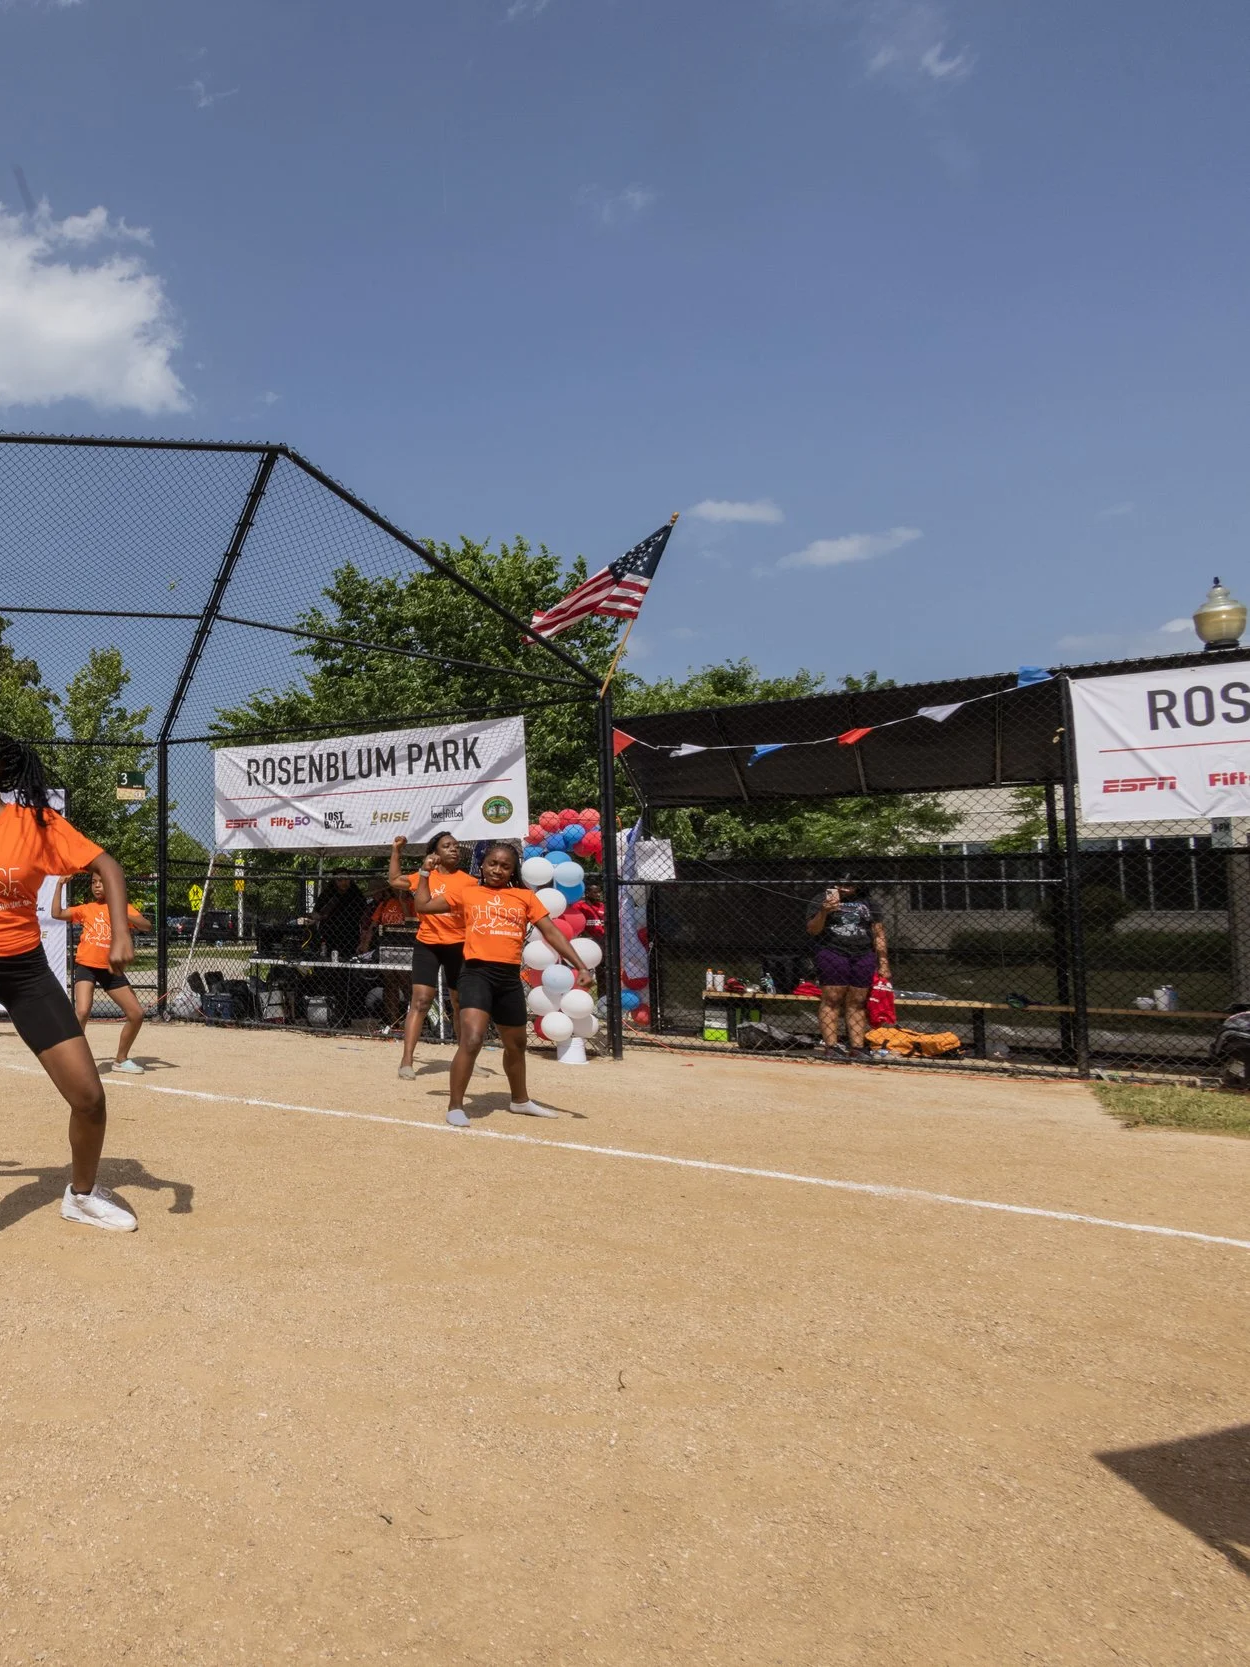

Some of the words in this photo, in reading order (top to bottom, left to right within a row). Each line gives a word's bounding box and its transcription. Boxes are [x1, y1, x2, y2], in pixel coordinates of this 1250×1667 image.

[246, 745, 397, 787] ROSENBLUM
[407, 736, 482, 775] PARK
[1102, 776, 1177, 793] ESPN
[1208, 771, 1250, 787] Fift
[324, 811, 344, 821] LOST
[379, 811, 410, 823] RISE
[225, 818, 258, 829] ESPN
